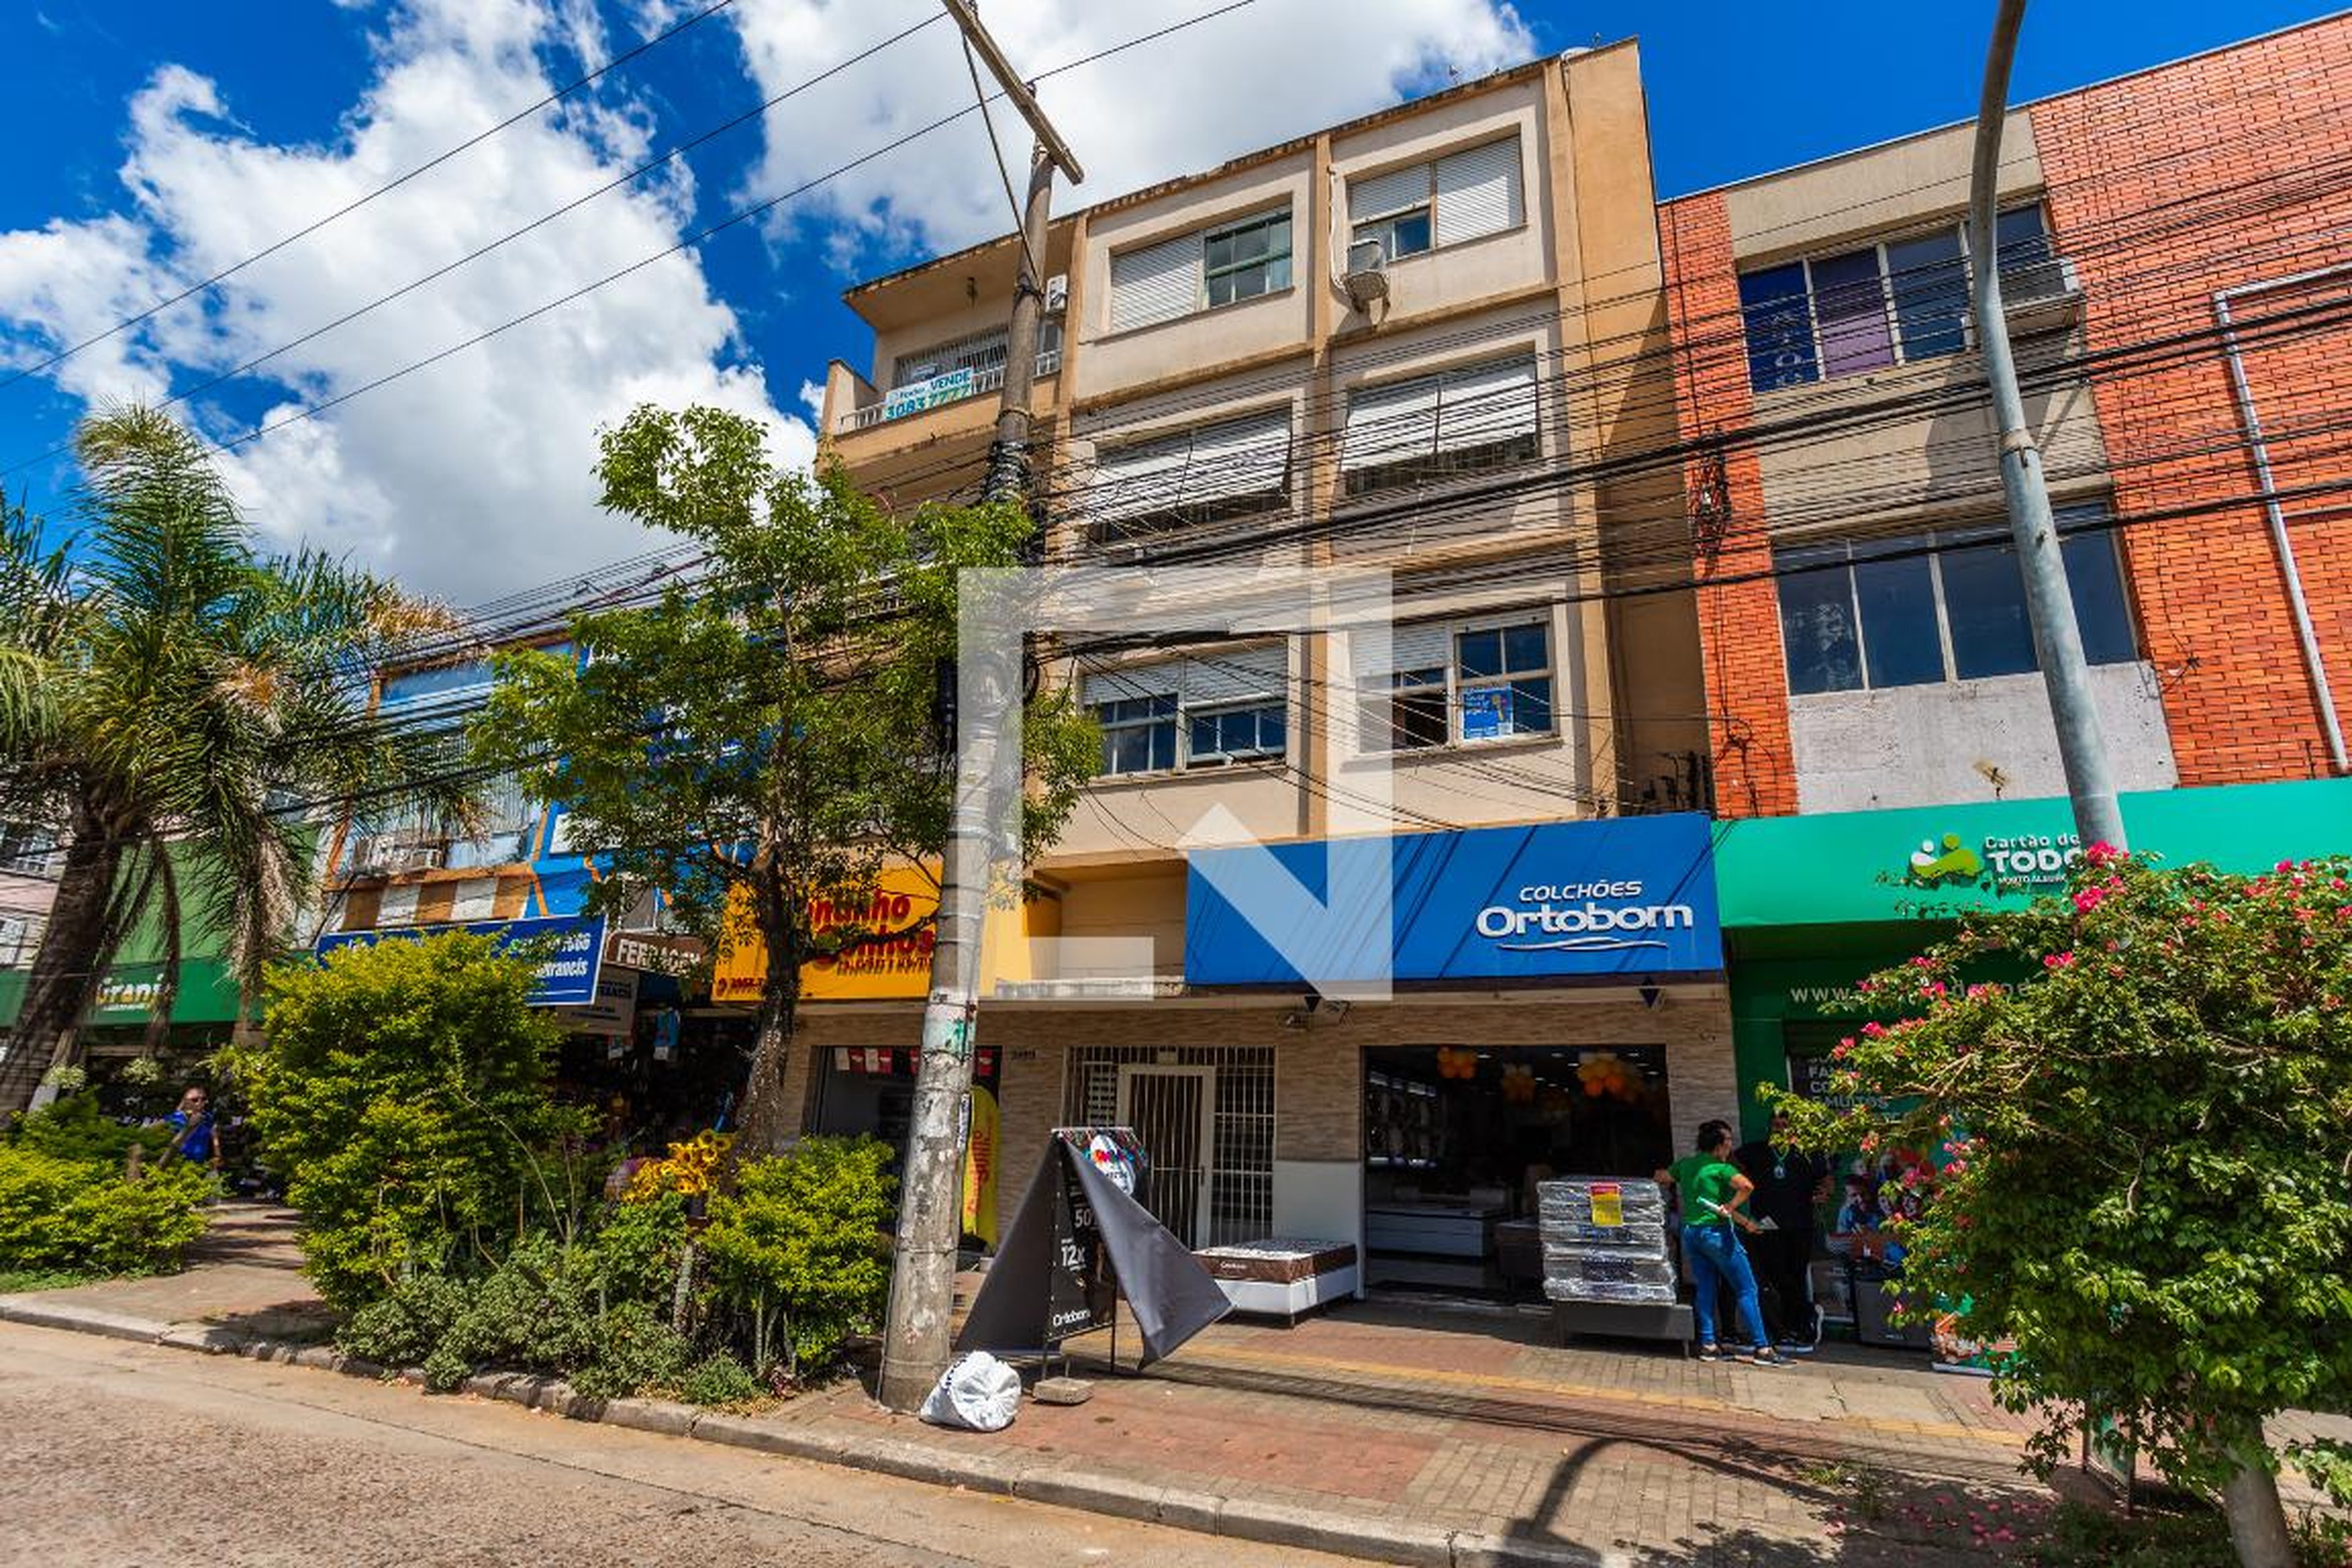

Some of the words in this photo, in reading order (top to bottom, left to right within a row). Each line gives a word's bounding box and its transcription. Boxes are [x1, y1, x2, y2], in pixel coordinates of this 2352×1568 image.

[930, 369, 971, 390] VENDE
[1985, 834, 2051, 849] Cartão
[1519, 880, 1643, 902] COLCHÕES
[1476, 902, 1694, 938] Ortobom
